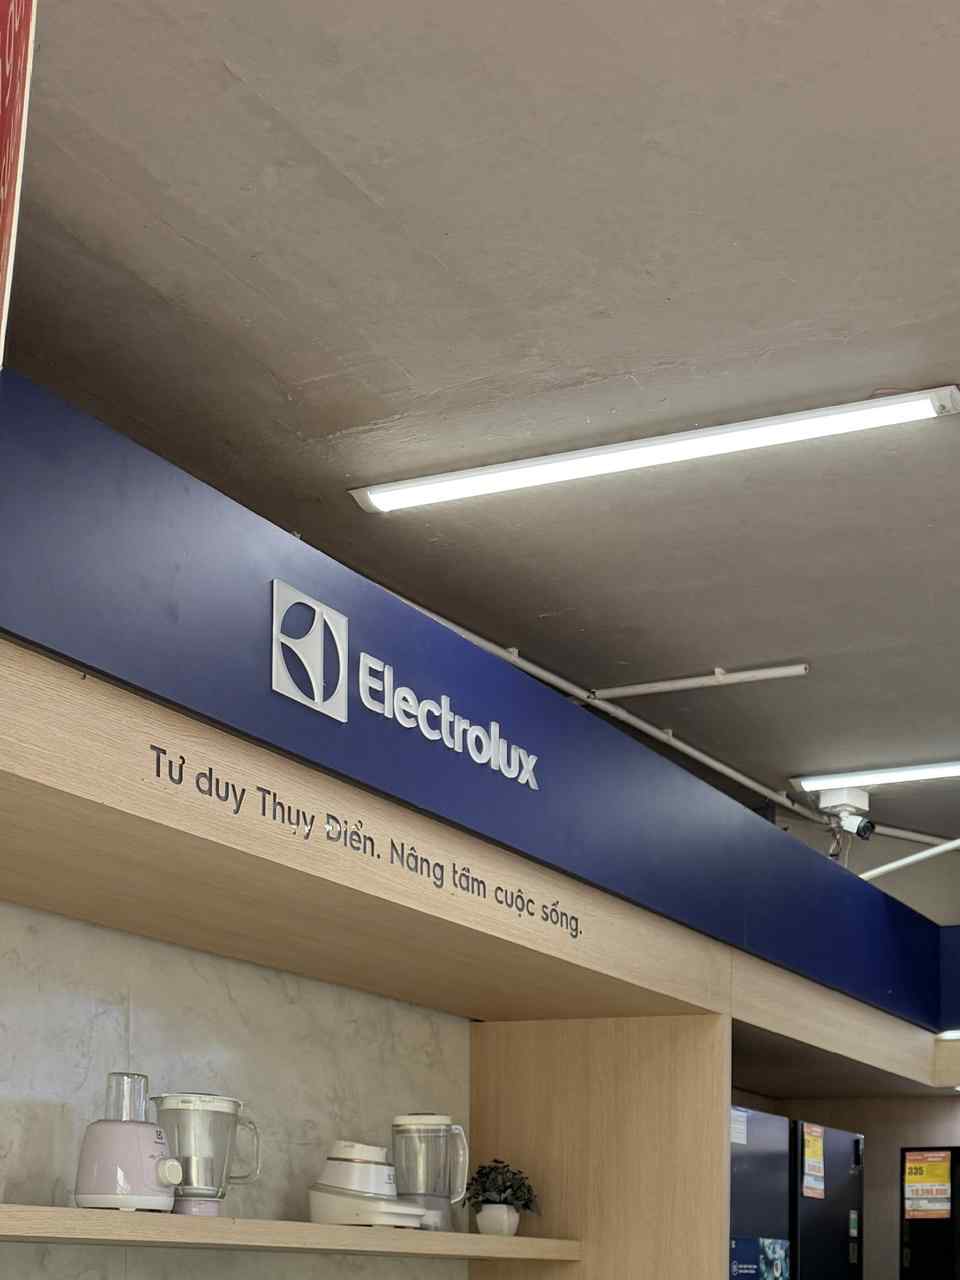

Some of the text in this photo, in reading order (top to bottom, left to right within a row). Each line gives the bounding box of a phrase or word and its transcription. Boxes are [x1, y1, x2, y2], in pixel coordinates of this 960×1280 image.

[359, 652, 539, 790] Electrolux
[150, 744, 583, 938] Tư duy Thụy Điển. Nâng tầm cuộc sống.
